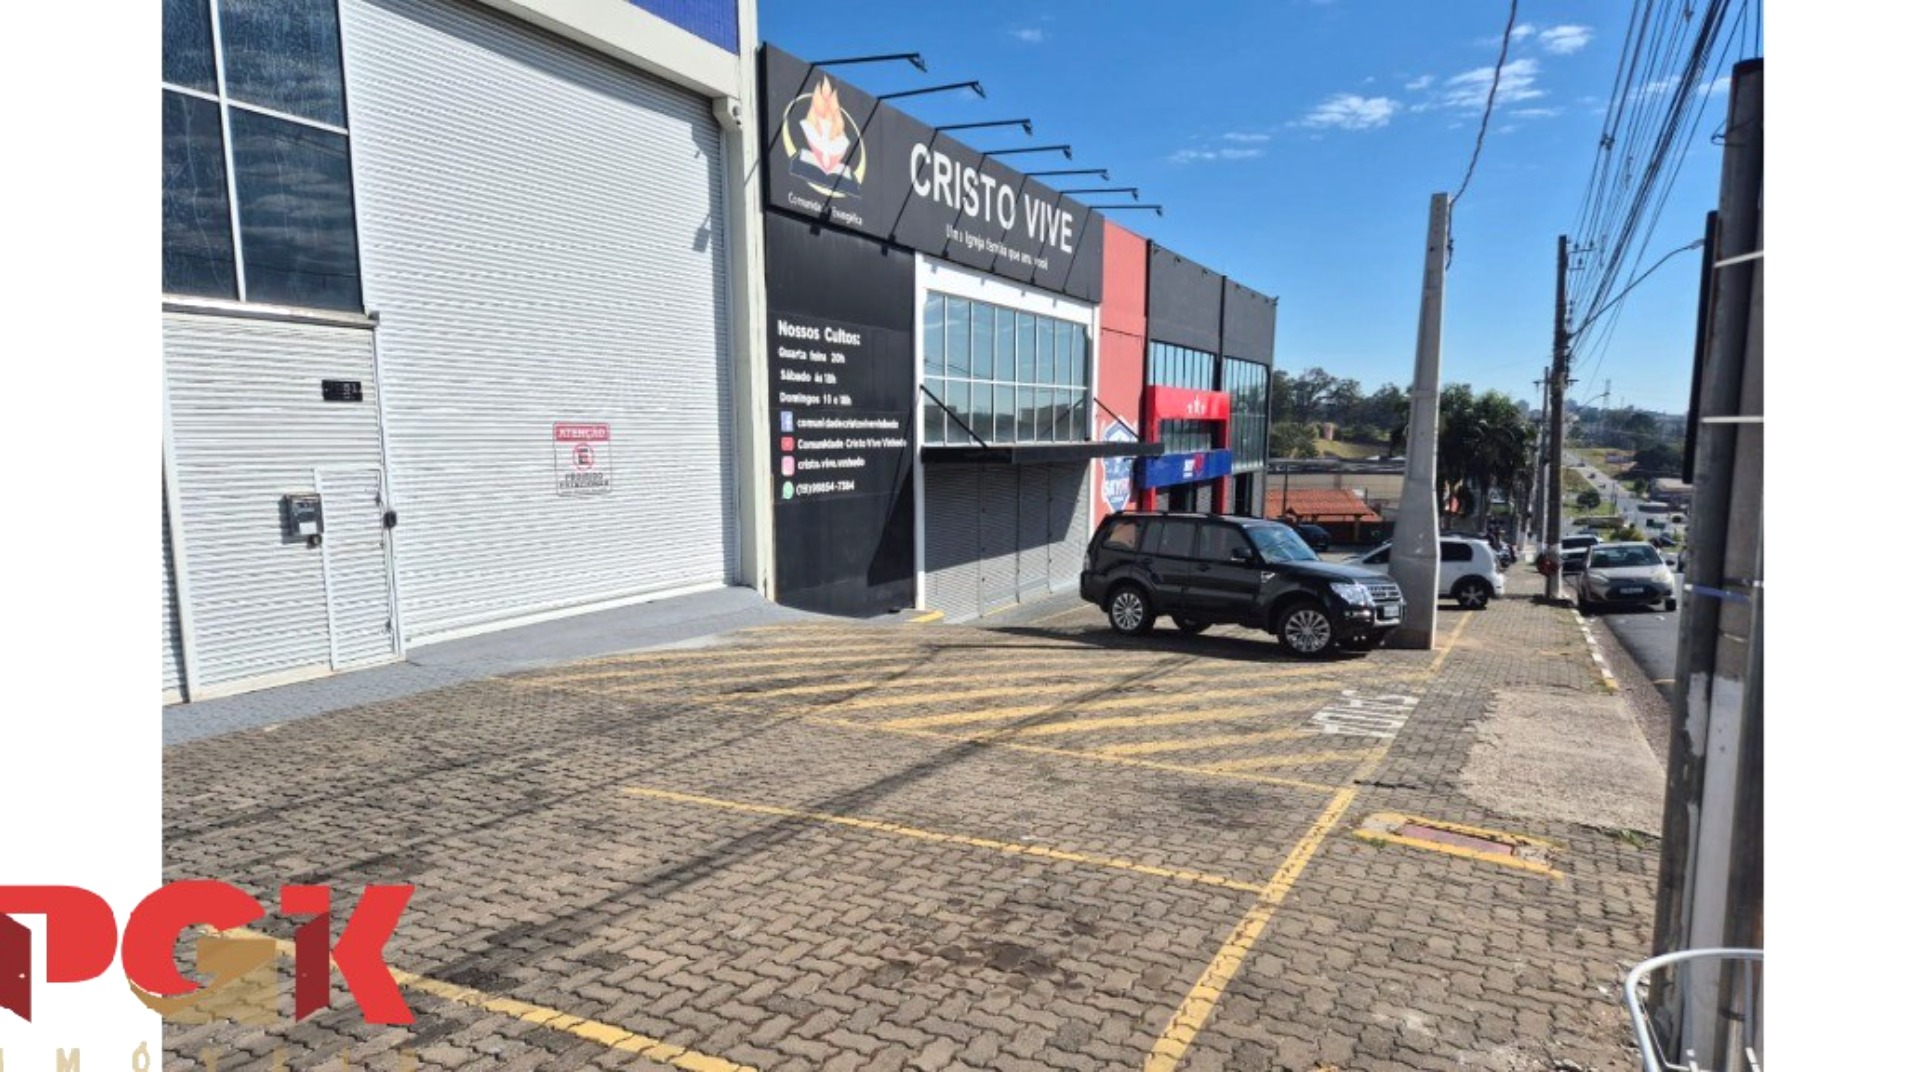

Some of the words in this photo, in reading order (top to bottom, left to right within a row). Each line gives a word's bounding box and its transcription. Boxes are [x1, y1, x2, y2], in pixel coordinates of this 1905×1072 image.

[910, 142, 1016, 231] CRISTO
[1024, 193, 1074, 254] VIVE
[777, 319, 820, 341] Nossos
[823, 326, 861, 346] Cultos:
[778, 346, 807, 360] Quarta
[780, 368, 811, 383] Sábado
[779, 392, 820, 406] Domingos
[797, 438, 844, 450] Comunidade
[845, 437, 866, 448] Cristo
